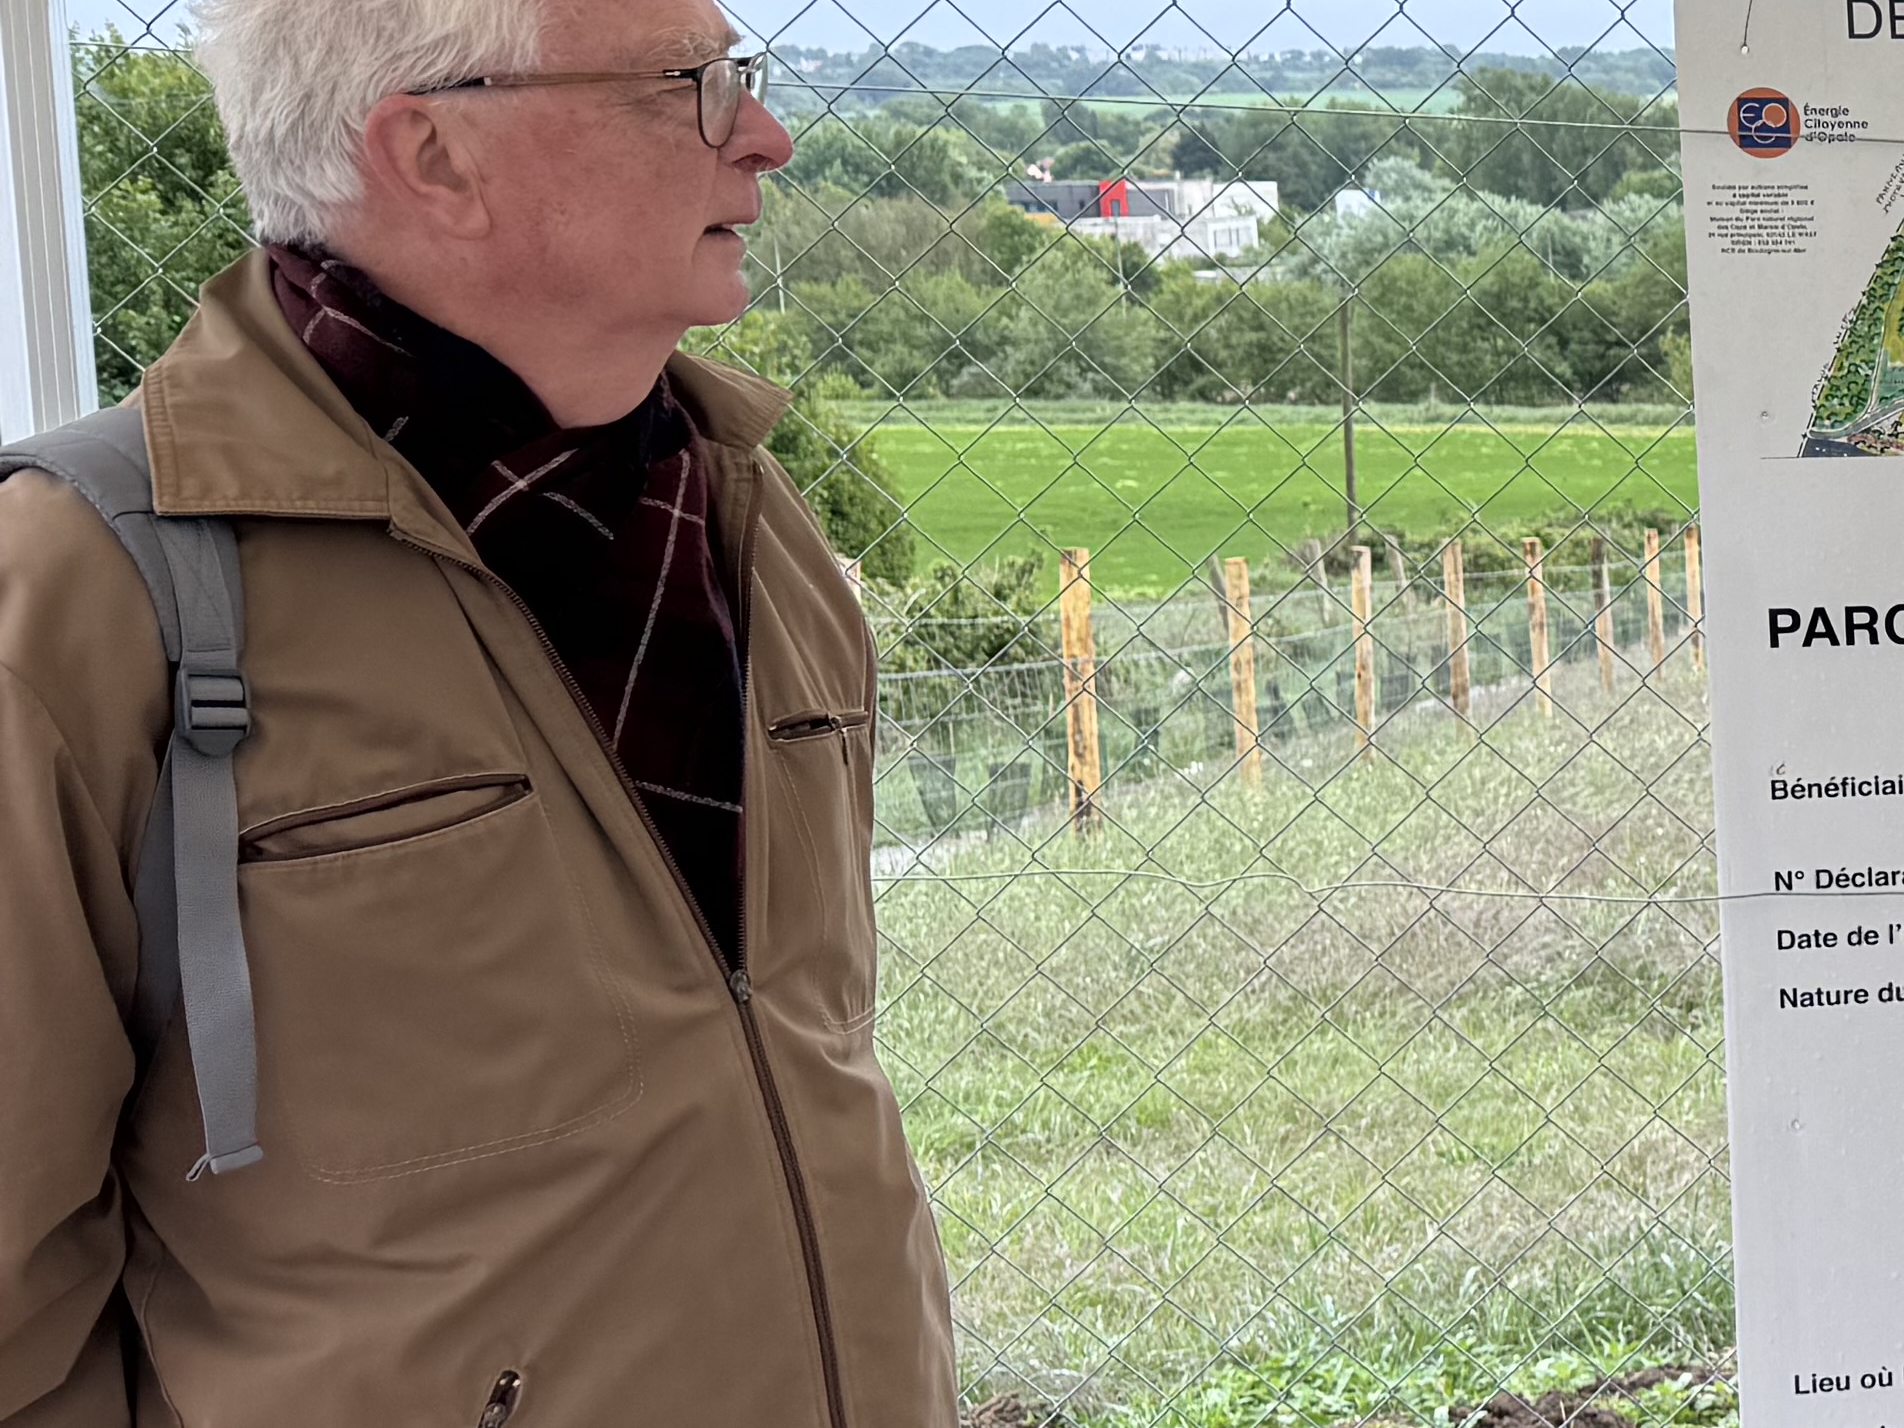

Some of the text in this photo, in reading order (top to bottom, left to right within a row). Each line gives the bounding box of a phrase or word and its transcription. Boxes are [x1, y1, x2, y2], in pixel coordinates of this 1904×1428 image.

[1803, 102, 1850, 118] Énergie
[1804, 118, 1869, 131] Citoyenne
[1774, 870, 1805, 892] N°
[1777, 929, 1838, 951] Date
[1847, 925, 1880, 947] de
[1779, 987, 1869, 1009] Nature
[1794, 1373, 1851, 1395] Lieu
[1860, 1366, 1893, 1389] où
